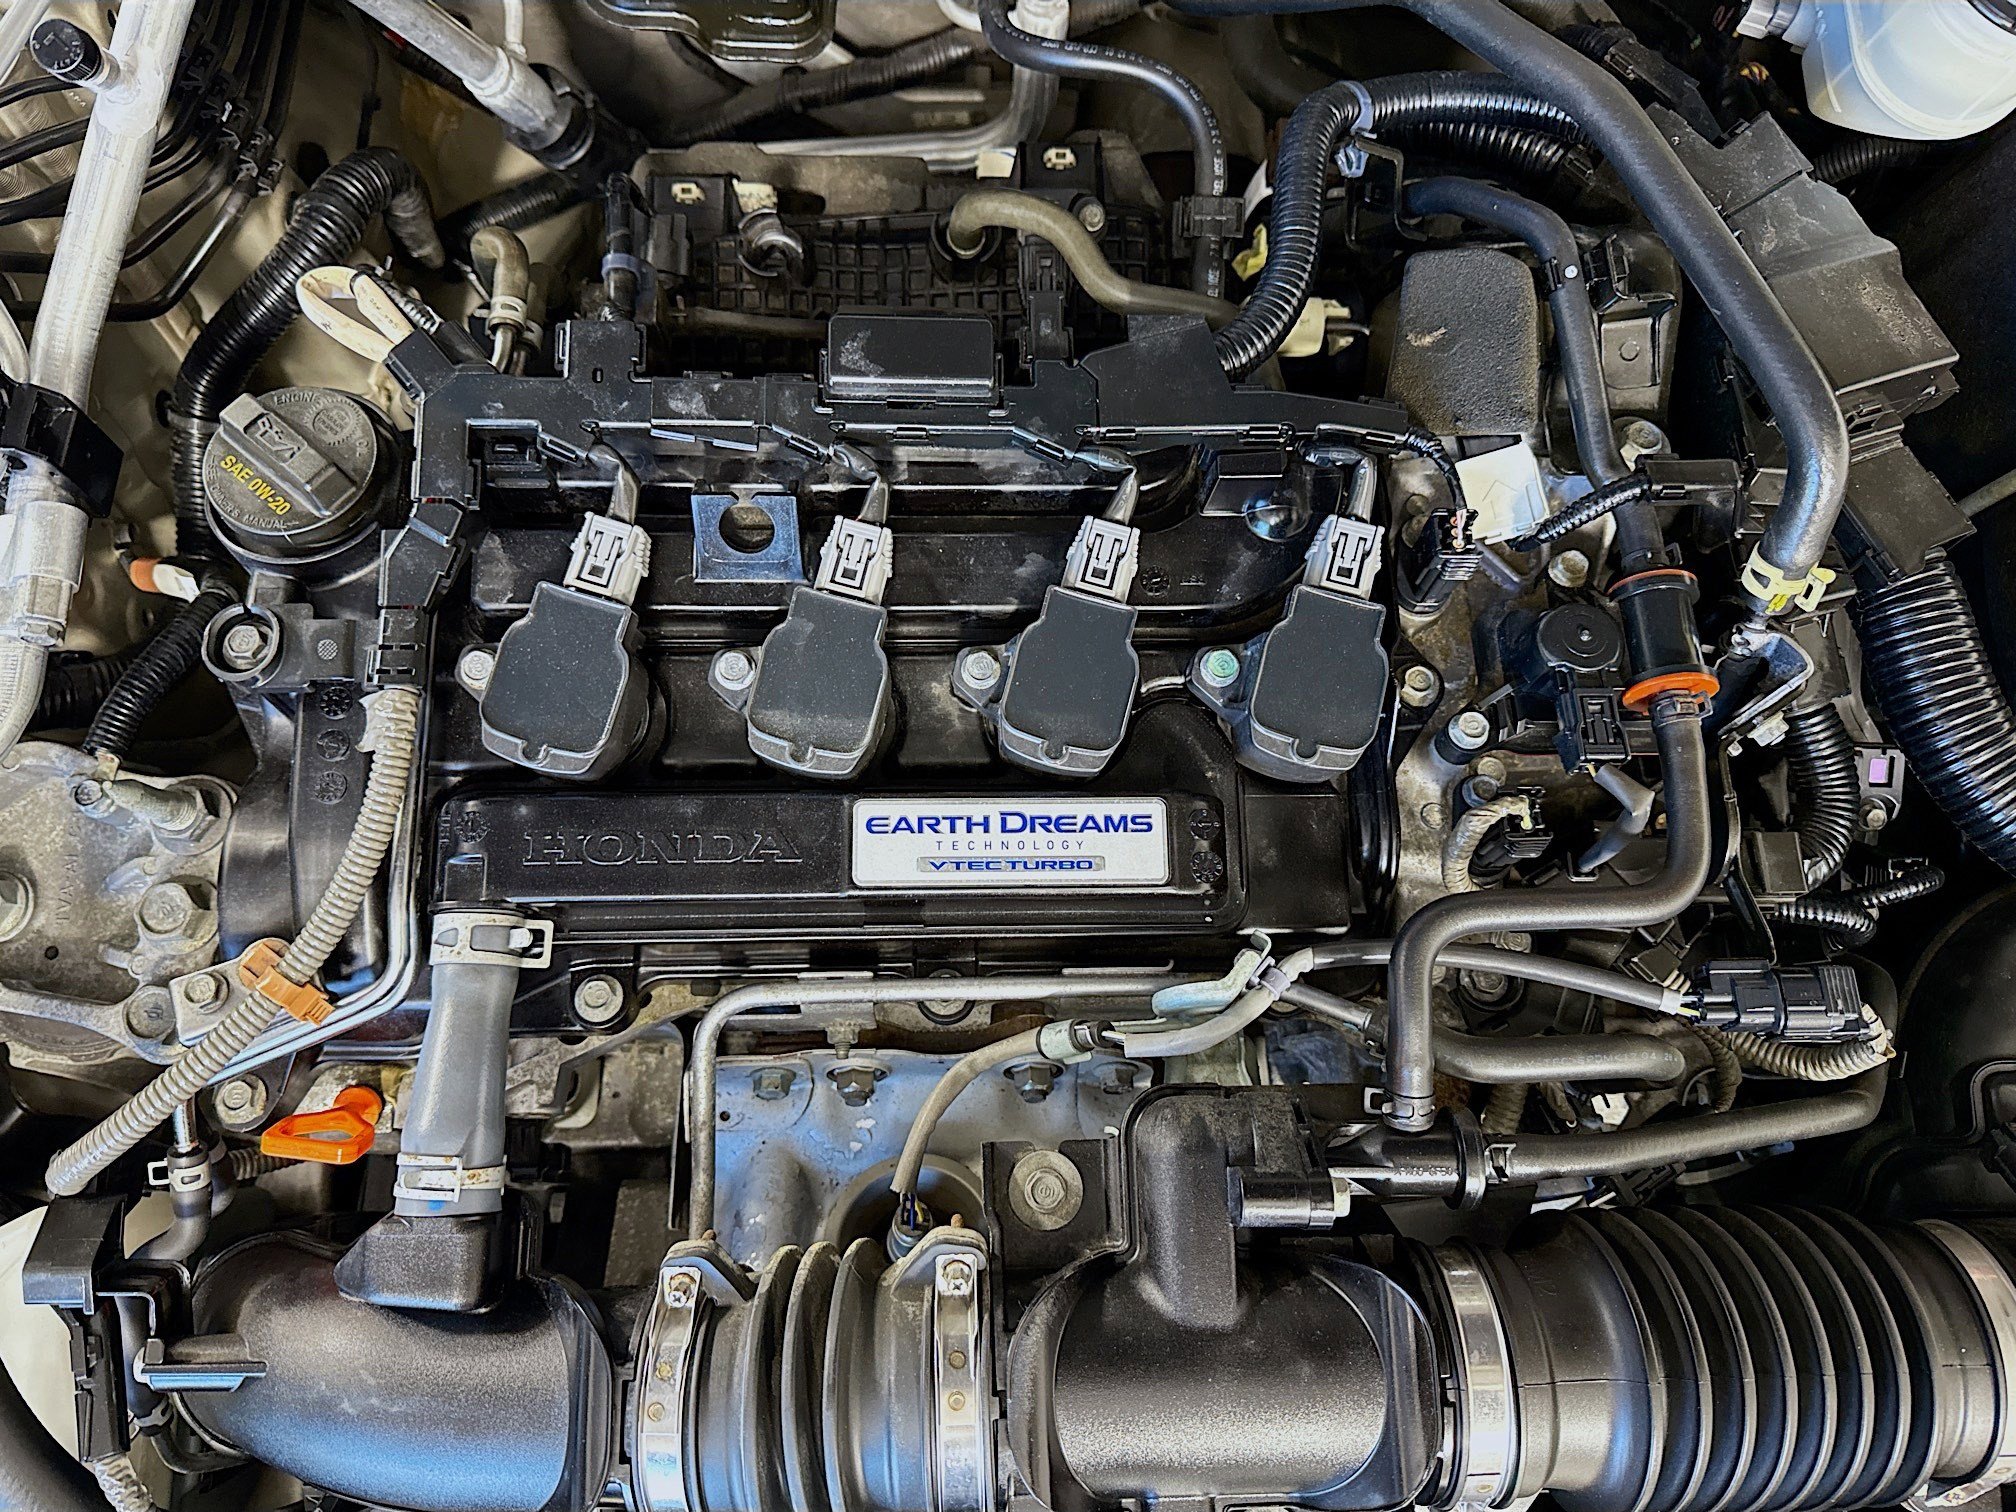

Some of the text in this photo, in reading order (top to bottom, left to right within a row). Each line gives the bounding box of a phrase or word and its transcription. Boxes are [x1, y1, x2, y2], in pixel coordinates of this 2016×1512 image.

[219, 455, 292, 516] SAE 0W-20
[242, 513, 288, 530] MANUAL
[864, 810, 1154, 835] EARTH DREAMS
[521, 829, 804, 867] HONDA
[935, 840, 1085, 851] TECHNOLOGY
[928, 859, 1094, 871] VTEC TURBO
